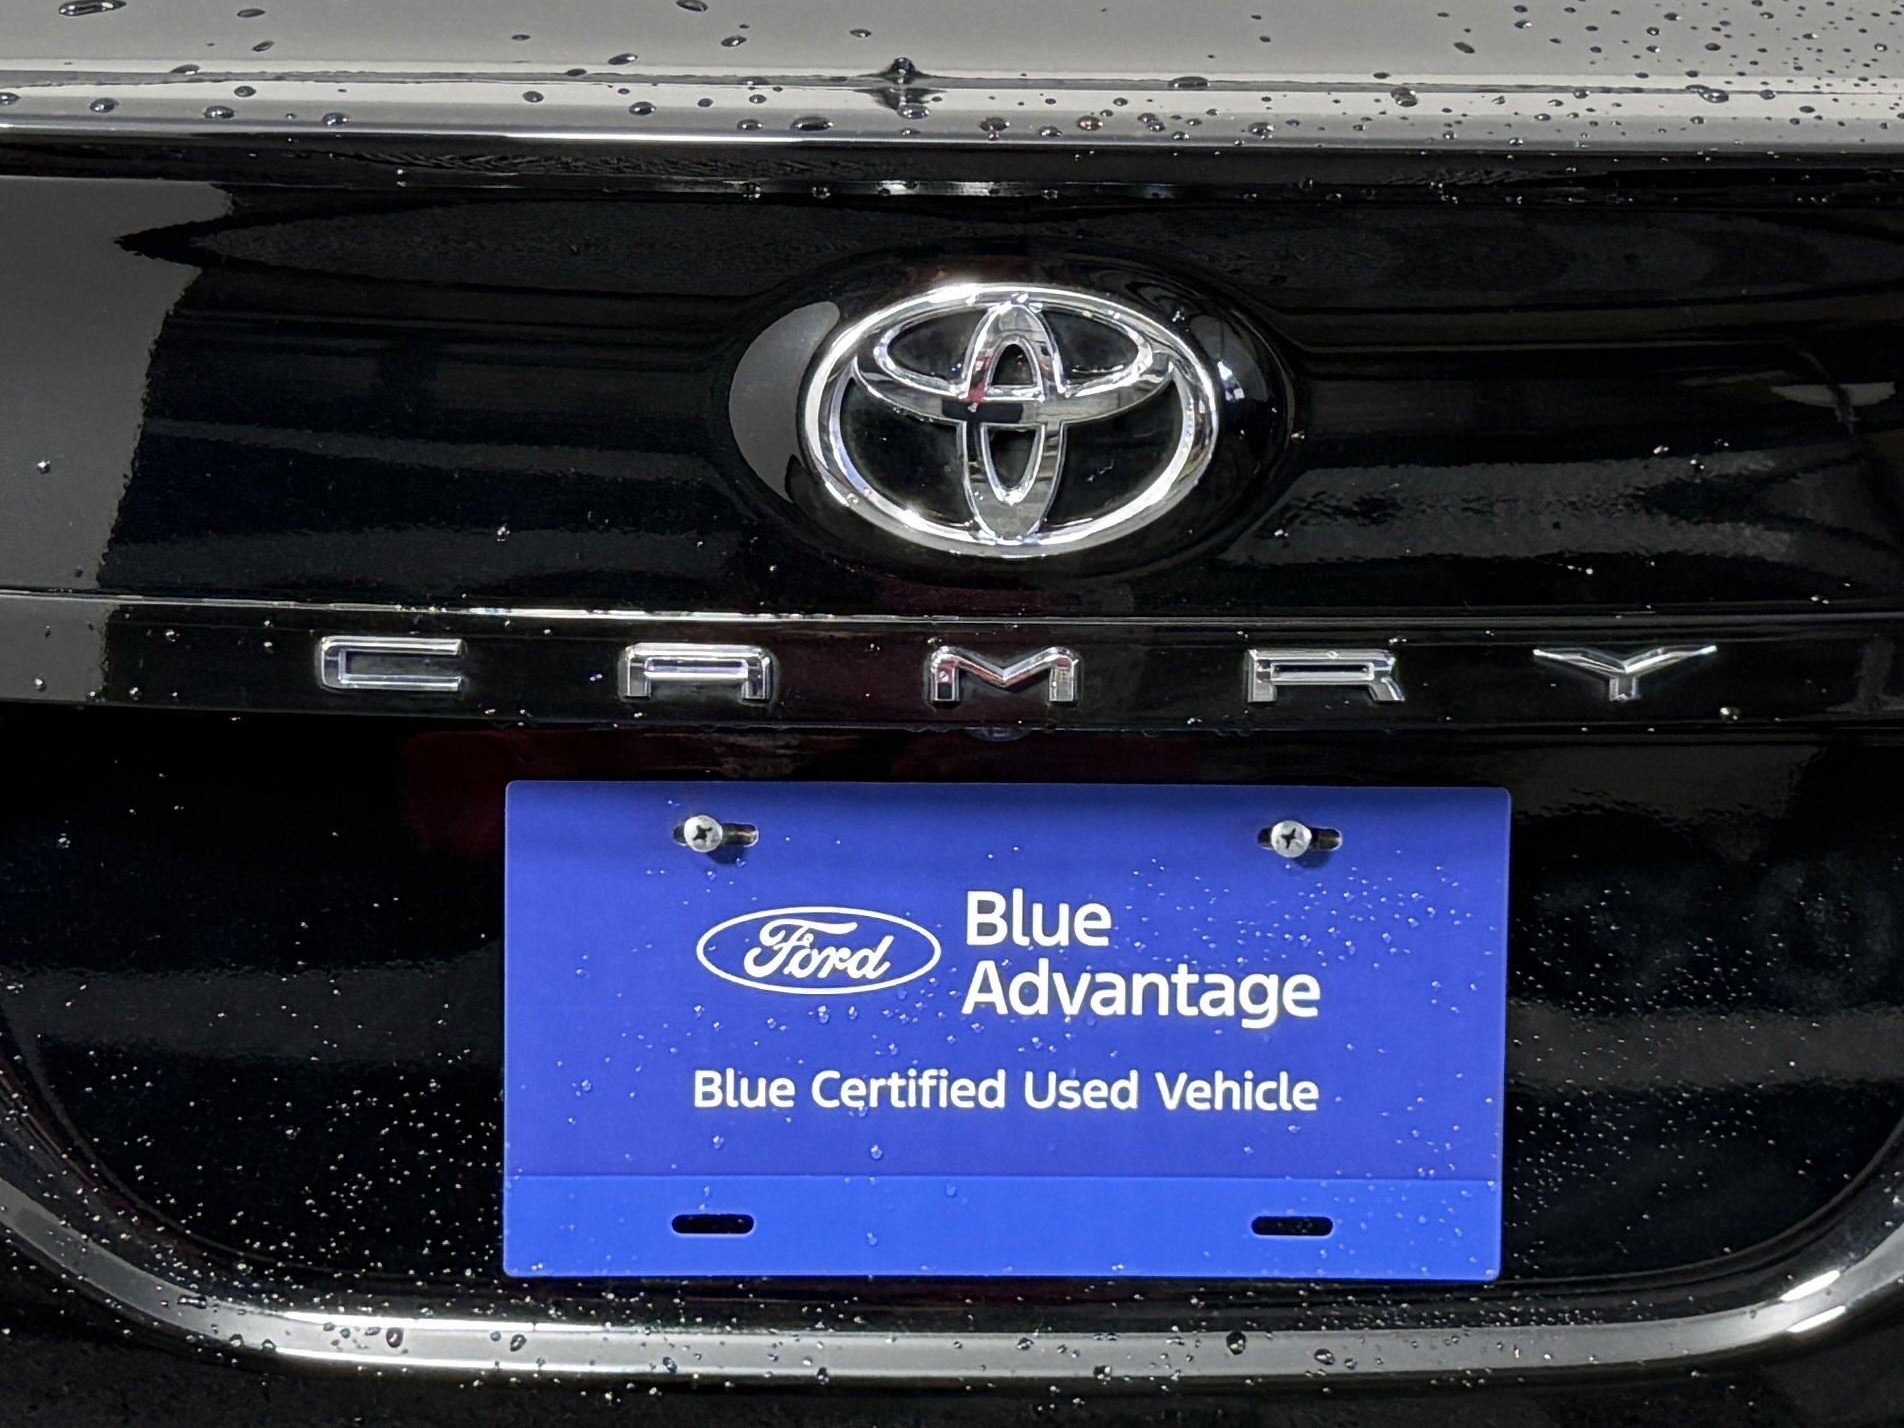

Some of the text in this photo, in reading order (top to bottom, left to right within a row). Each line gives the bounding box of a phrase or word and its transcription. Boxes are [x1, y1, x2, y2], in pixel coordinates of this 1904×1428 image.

[315, 633, 1722, 704] CAMRY
[742, 917, 893, 981] Ford
[965, 887, 1112, 948] Blue
[961, 958, 1322, 1030] Advantage
[692, 1066, 1320, 1112] Blue Certified Used Vehicle
